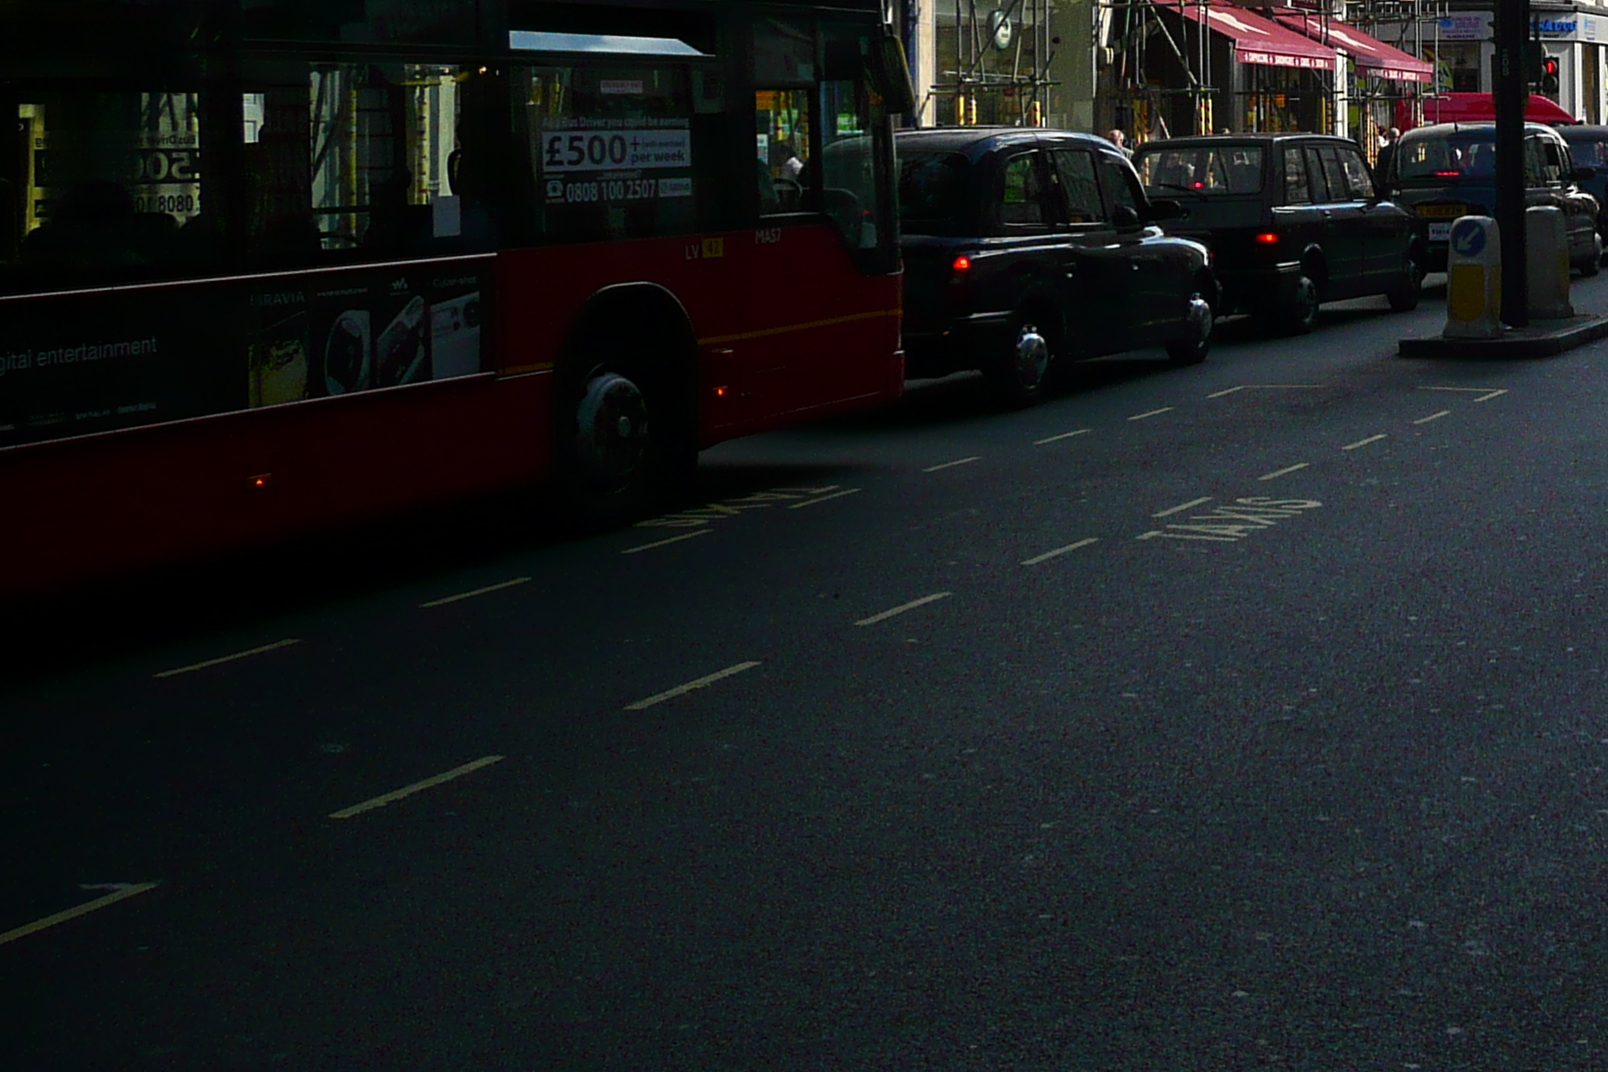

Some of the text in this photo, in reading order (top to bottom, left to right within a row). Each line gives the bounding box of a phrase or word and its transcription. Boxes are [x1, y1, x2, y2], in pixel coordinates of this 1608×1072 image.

[545, 134, 627, 167] £500
[631, 149, 685, 166] per week
[565, 181, 598, 204] 0808
[601, 180, 625, 202] 100
[626, 178, 657, 200] 2507
[36, 334, 158, 367] entertainment
[1135, 496, 1323, 542] TAXIS
